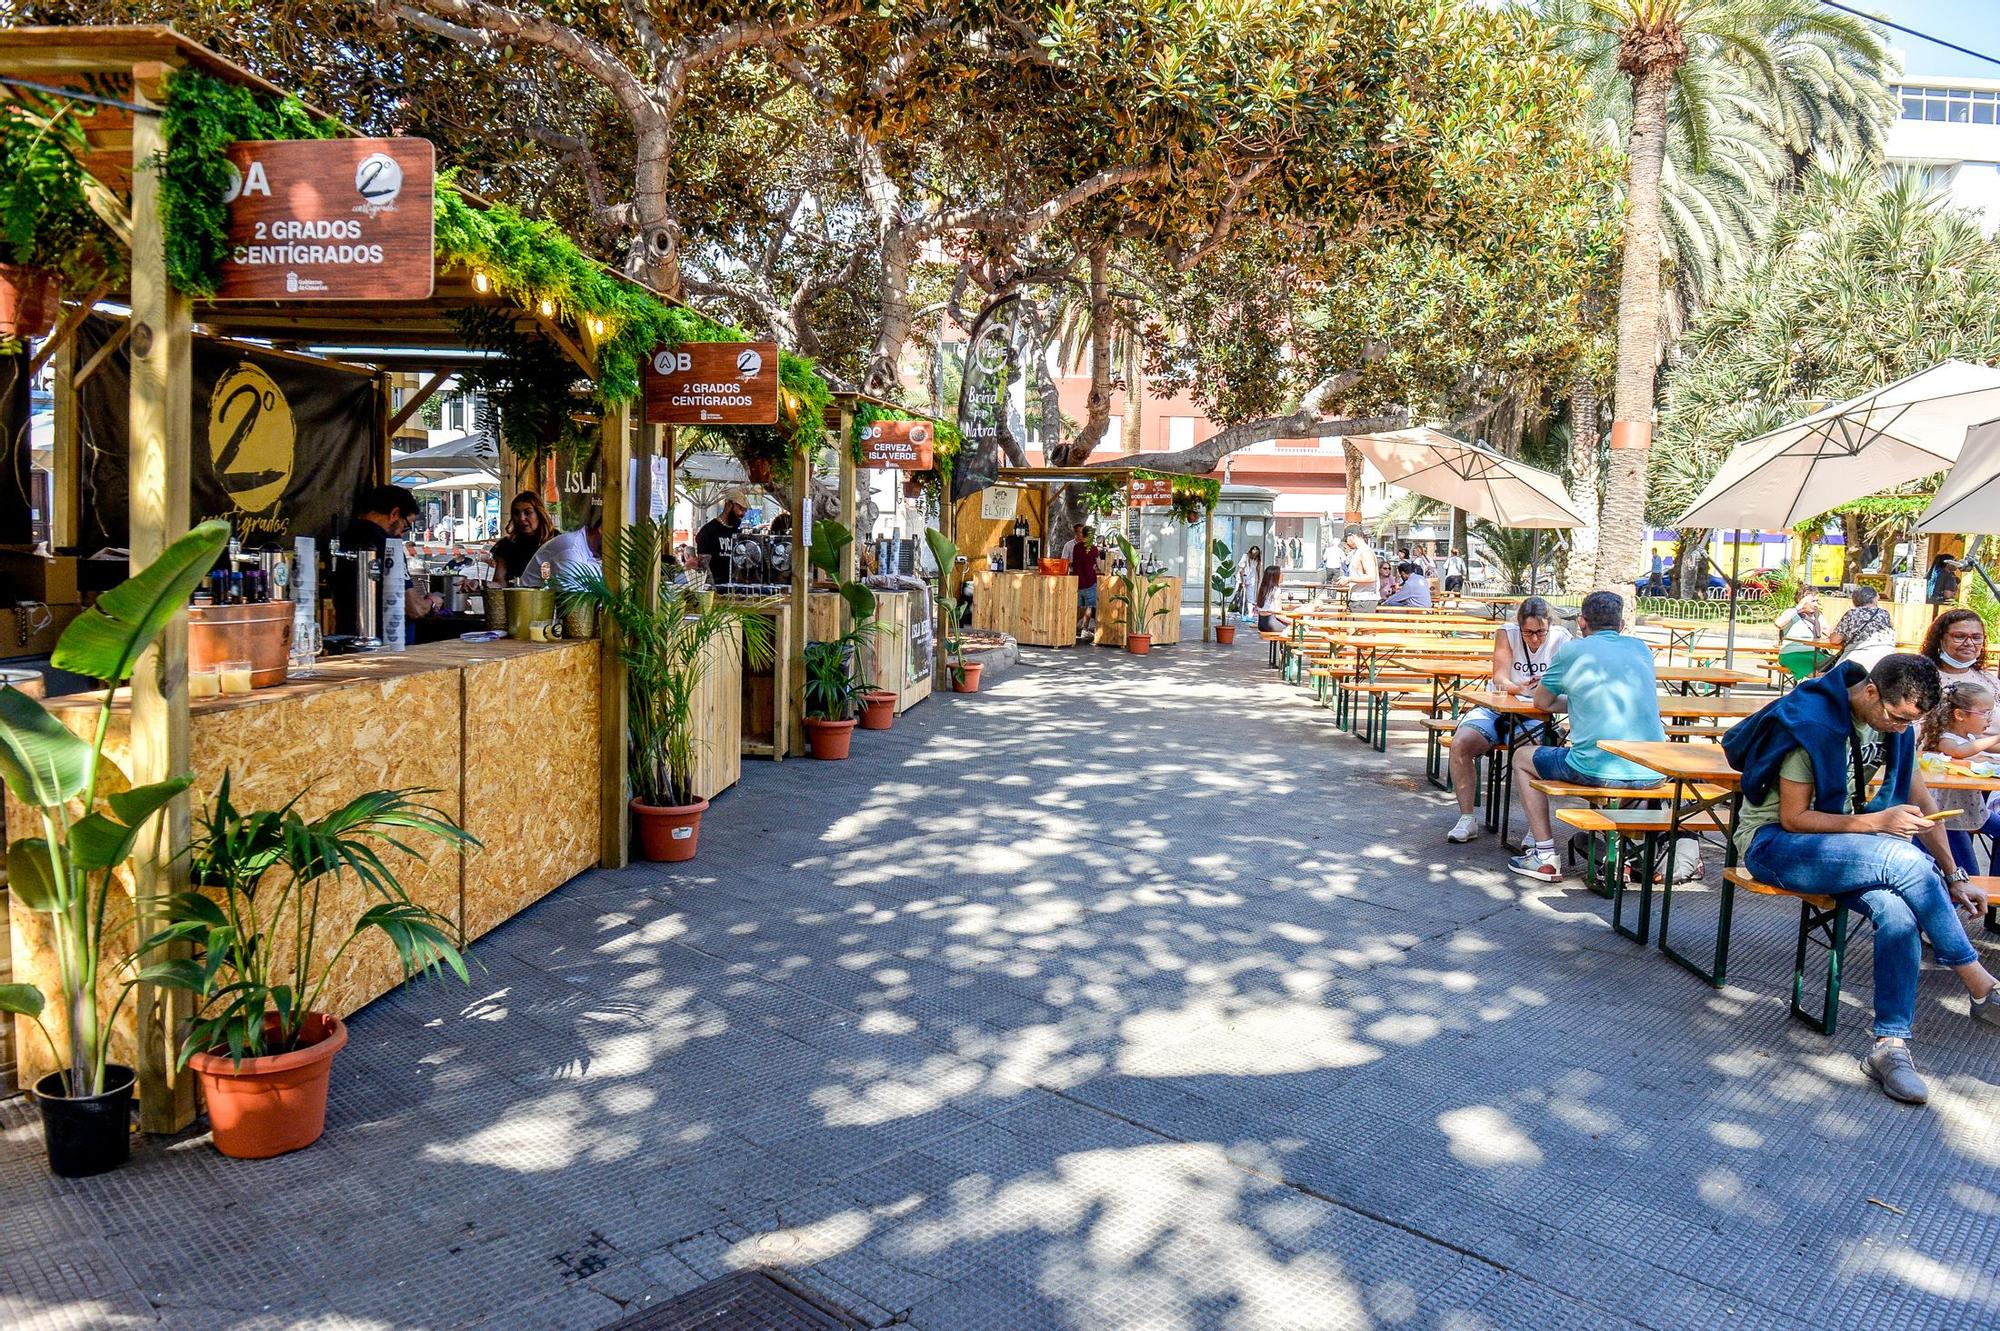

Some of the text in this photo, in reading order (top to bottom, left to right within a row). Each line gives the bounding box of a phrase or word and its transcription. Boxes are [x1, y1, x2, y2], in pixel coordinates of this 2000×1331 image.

[255, 220, 362, 239] 2 GRADOS
[234, 241, 384, 264] CENTÍGRADOS
[683, 384, 740, 393] 2 GRADOS
[672, 394, 752, 405] CENTÍGRADOS
[968, 385, 998, 405] Brind
[874, 443, 913, 452] CERVEZA
[869, 452, 917, 460] ISLA VERDE
[1514, 661, 1547, 673] GOOD
